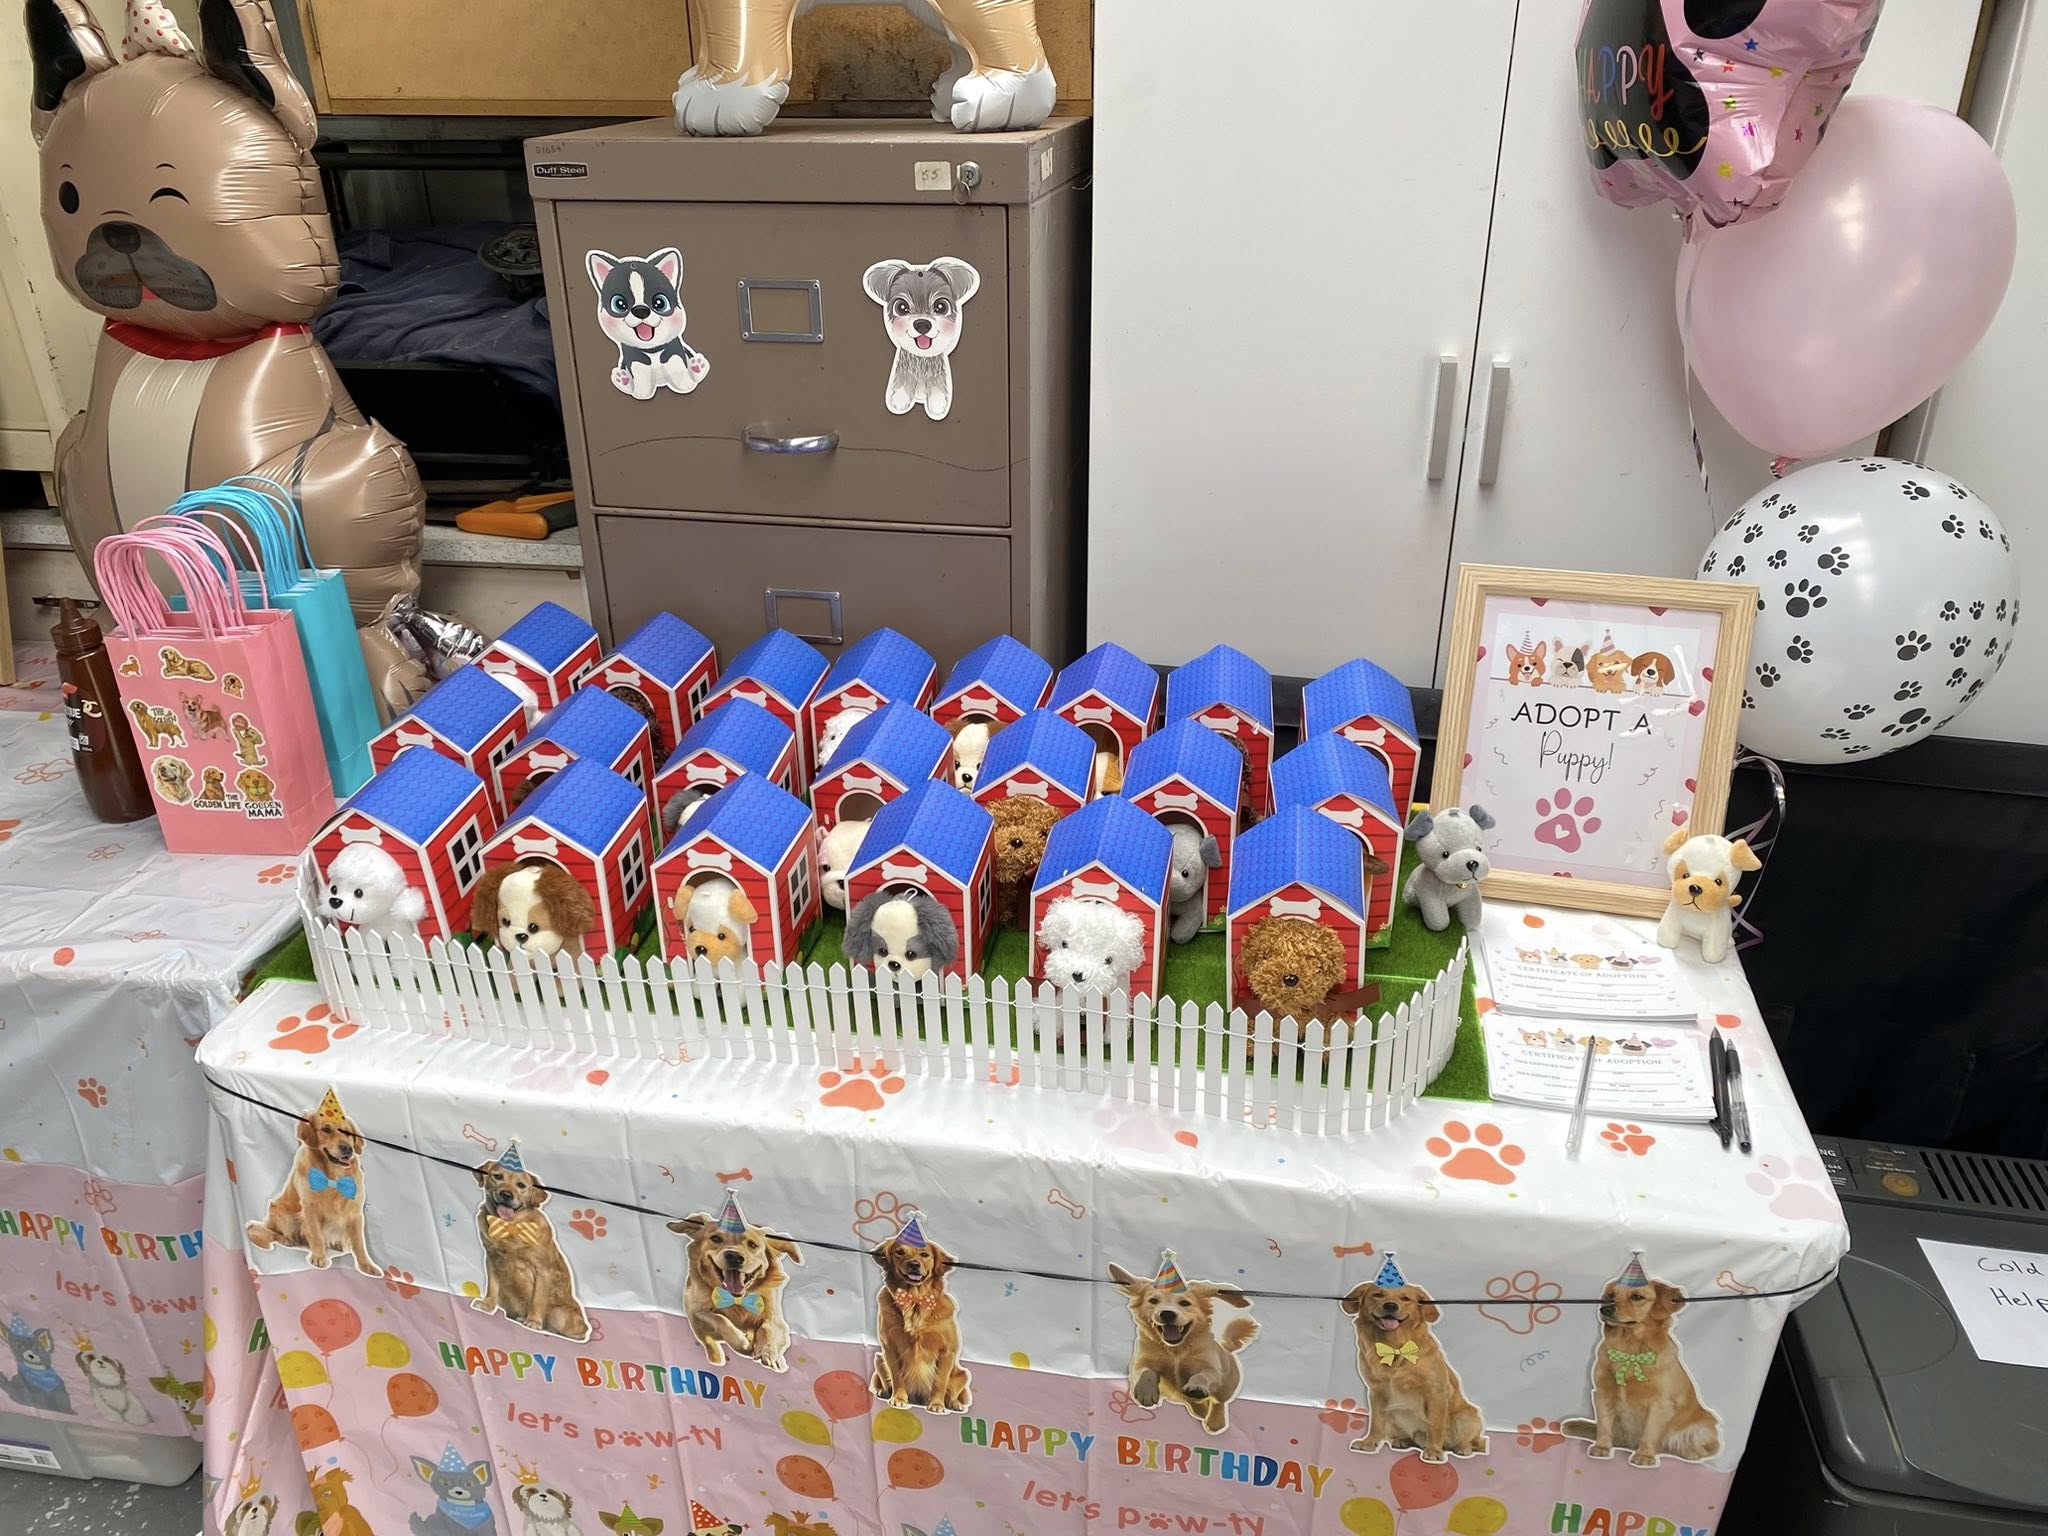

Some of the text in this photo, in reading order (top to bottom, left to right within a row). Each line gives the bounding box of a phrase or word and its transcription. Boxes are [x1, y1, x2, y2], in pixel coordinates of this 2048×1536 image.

[536, 166, 585, 174] Duff Steel
[1510, 701, 1652, 735] ADOPT A
[1539, 729, 1615, 785] Puppy!
[193, 799, 241, 810] GOLDEN LIFE
[244, 801, 282, 810] GOLDEN
[248, 808, 283, 818] MAMA
[0, 1210, 203, 1262] HAPPY BIRTH
[1978, 1257, 2045, 1276] Cold
[438, 1341, 767, 1409] HAPPY BIRTHDAY
[507, 1402, 580, 1439] let's
[960, 1416, 1334, 1499] HAPPY BIRTHDAY
[1022, 1480, 1100, 1520] let's
